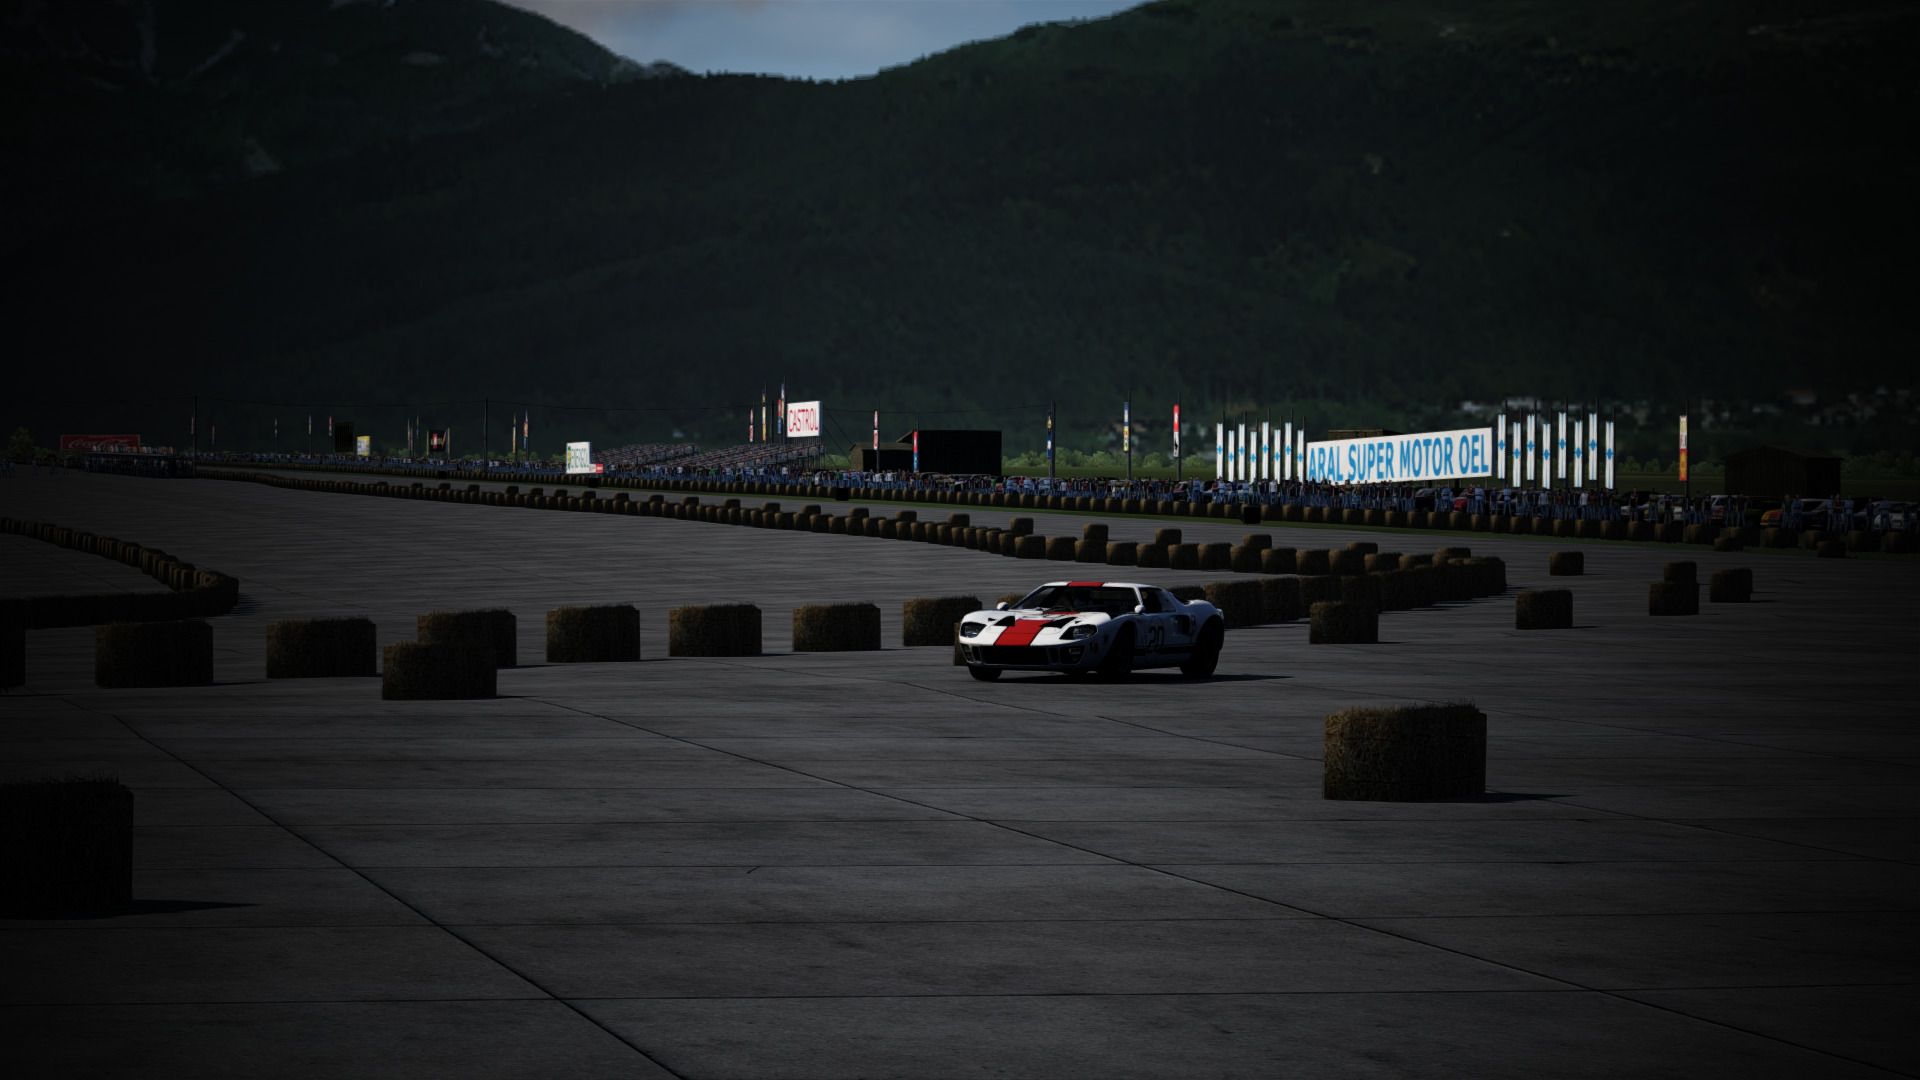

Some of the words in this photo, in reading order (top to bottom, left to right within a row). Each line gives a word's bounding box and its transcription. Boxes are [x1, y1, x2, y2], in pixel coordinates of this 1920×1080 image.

[789, 408, 819, 432] CASTROL
[1308, 445, 1343, 483] ARAL
[1348, 442, 1395, 482] SUPER
[1400, 437, 1453, 478] MOTOR
[1459, 434, 1489, 474] OEL
[1145, 626, 1165, 653] 20
